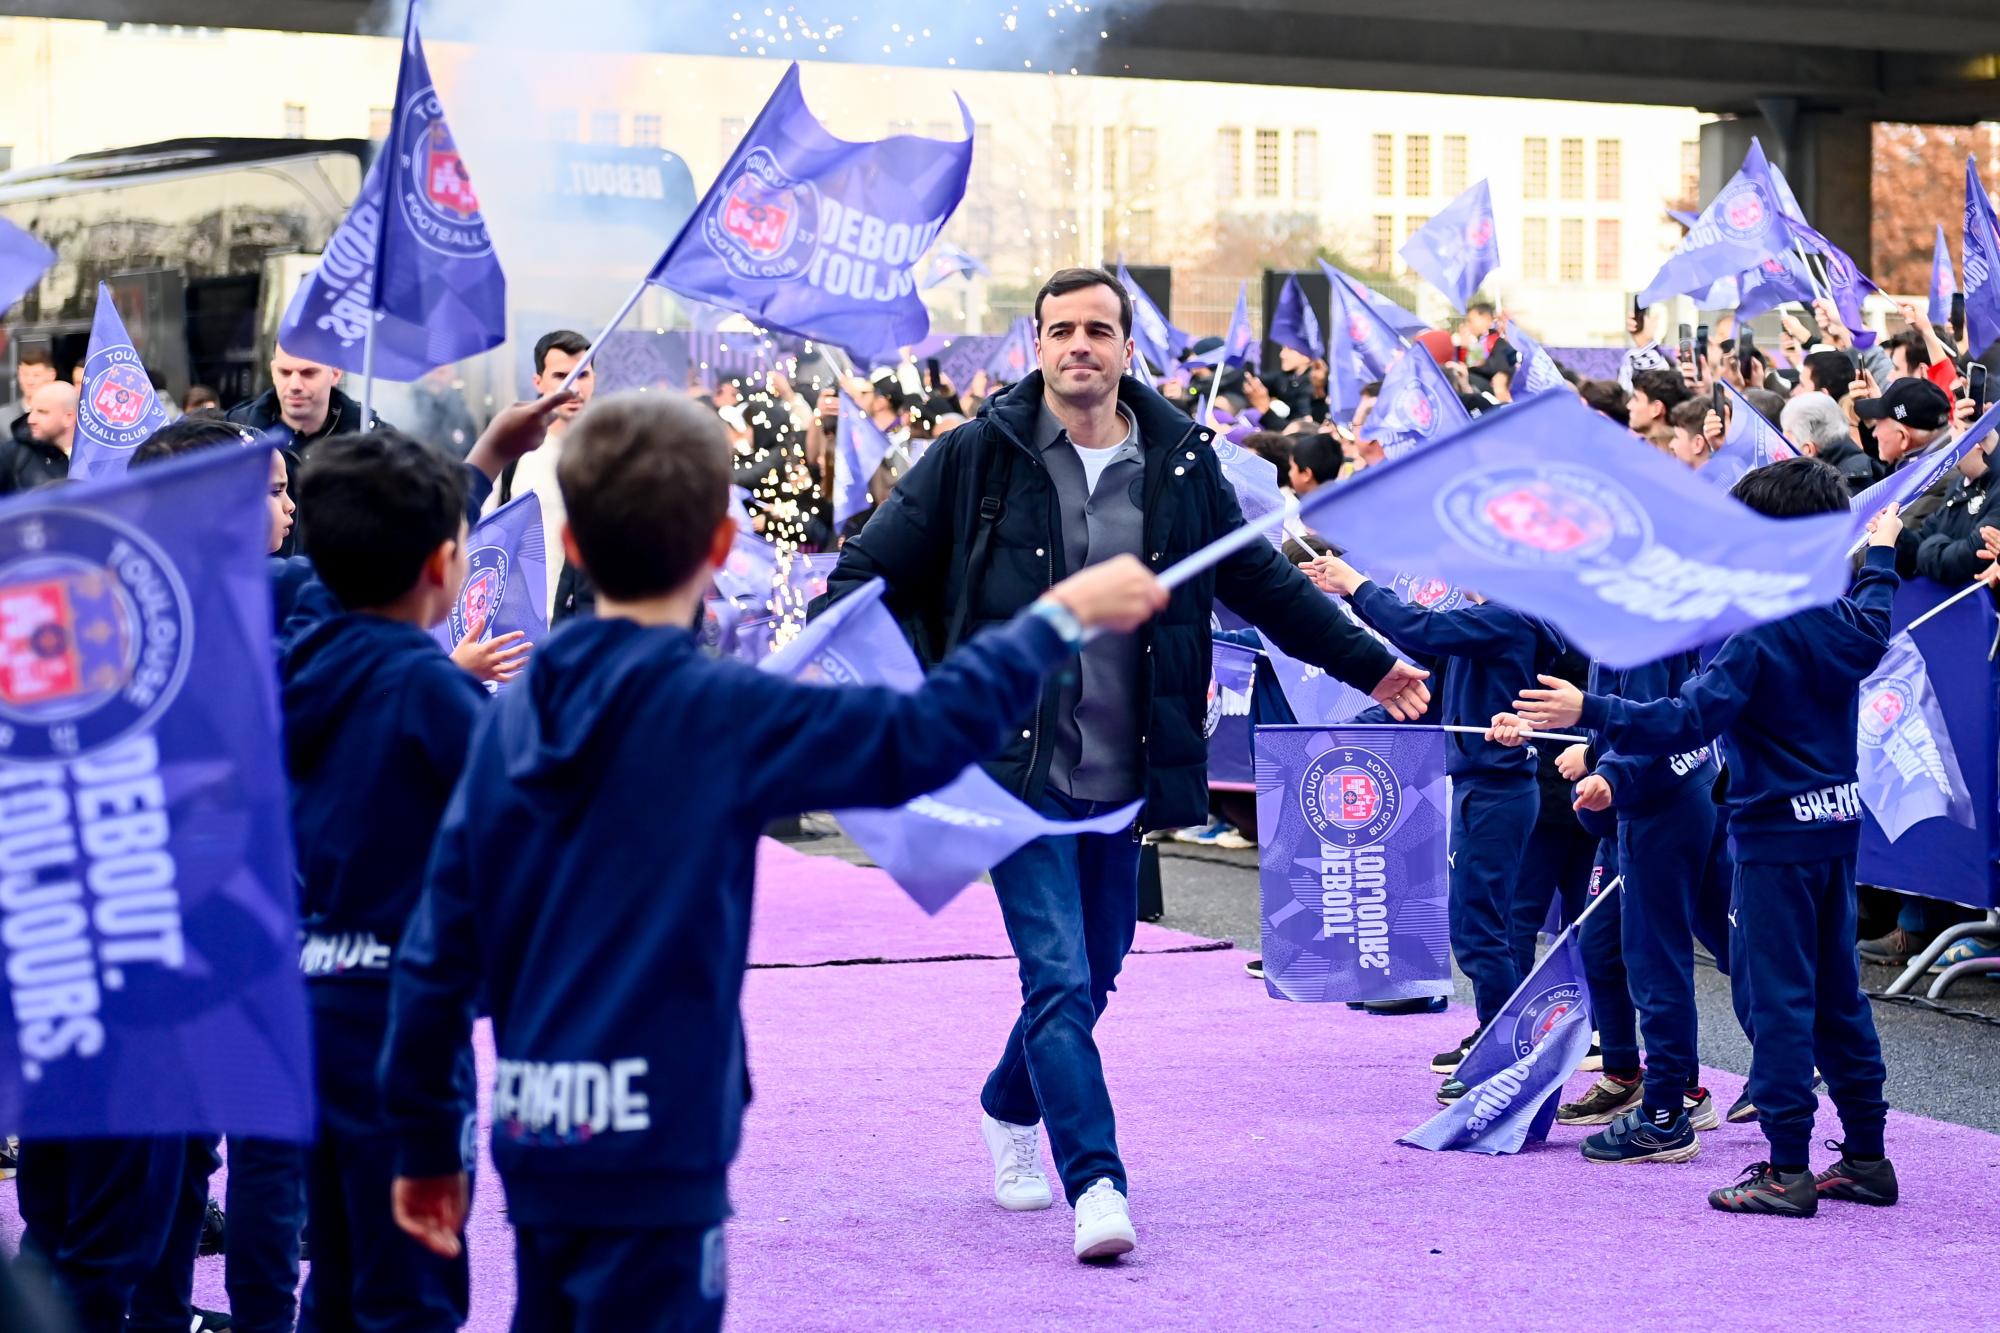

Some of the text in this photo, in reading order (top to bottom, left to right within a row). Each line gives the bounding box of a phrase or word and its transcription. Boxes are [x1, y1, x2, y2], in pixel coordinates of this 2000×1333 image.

[821, 197, 944, 266] DEBOU
[761, 257, 798, 276] CLUB
[105, 350, 140, 363] TOUL
[80, 399, 148, 442] FOOTBALL CLUB
[152, 407, 164, 417] 37
[472, 555, 481, 567] 19
[1790, 782, 1863, 821] GRENA
[71, 732, 186, 991] DEBOUT.
[493, 1057, 652, 1137] ENADE
